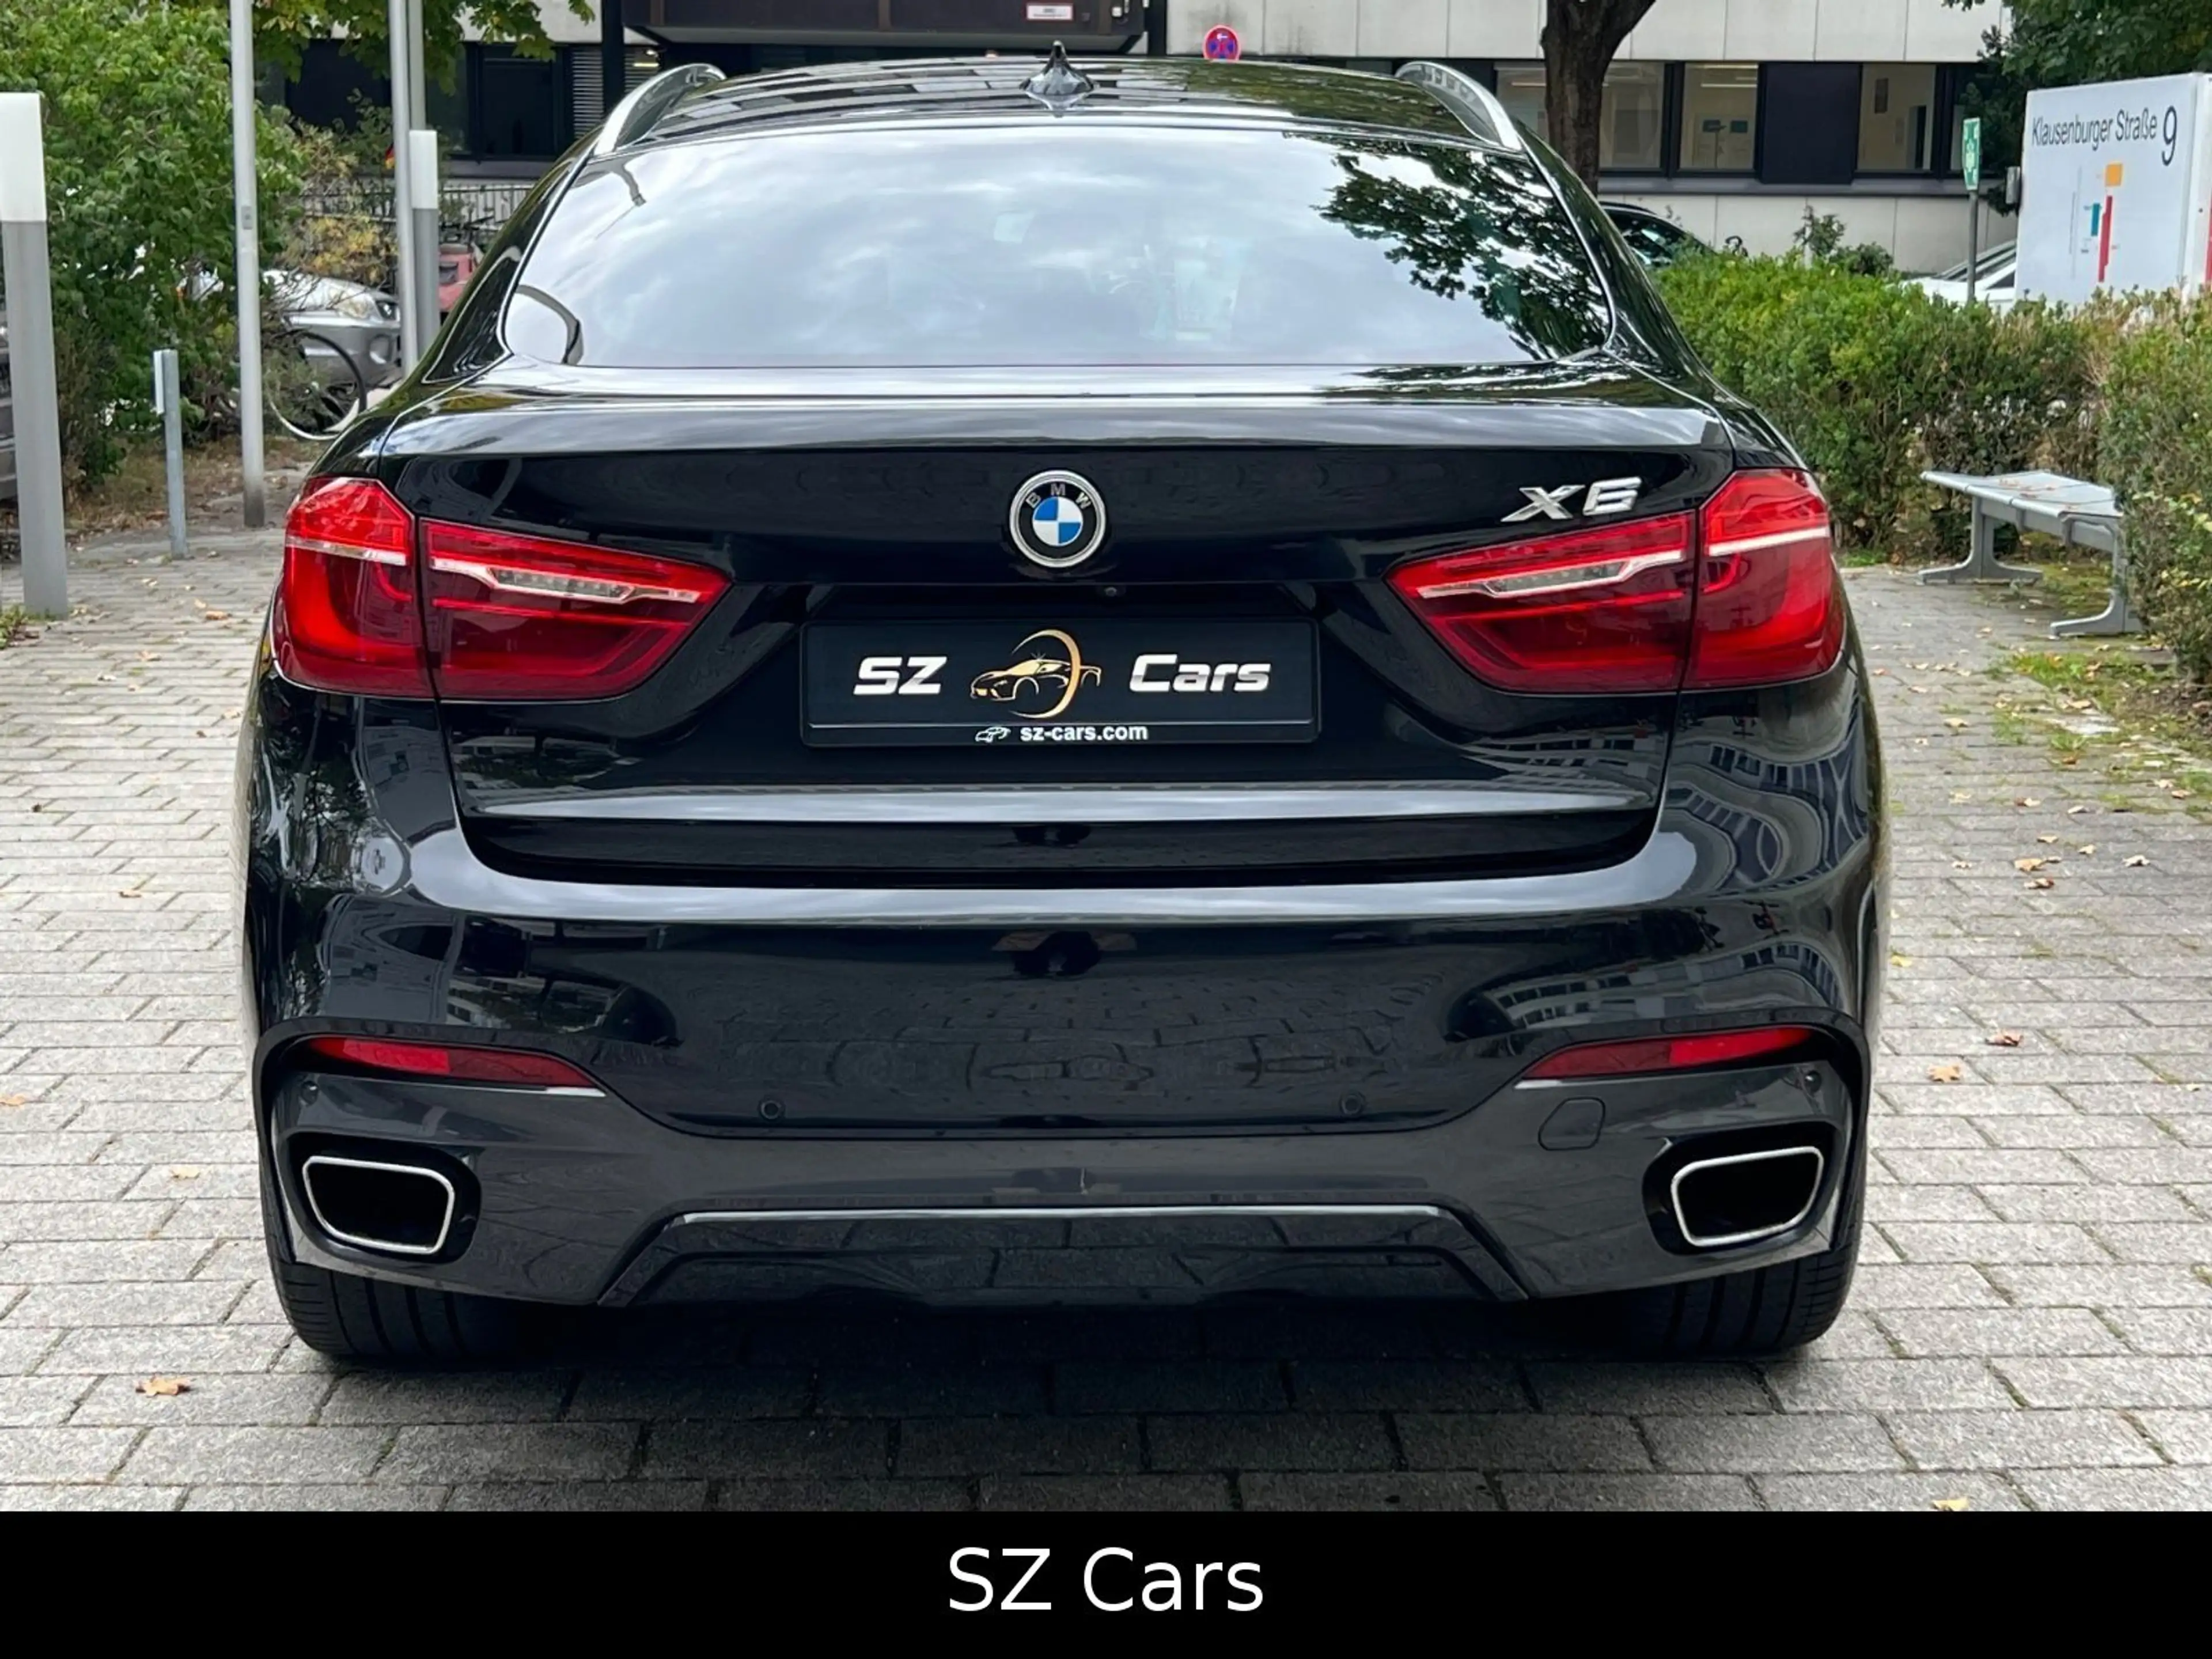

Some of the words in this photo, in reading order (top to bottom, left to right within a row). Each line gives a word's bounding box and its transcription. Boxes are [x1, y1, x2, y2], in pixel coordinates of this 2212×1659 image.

[2032, 115, 2113, 151] Klausenburger
[2115, 107, 2157, 141] Straße
[2161, 105, 2177, 166] 9
[1025, 483, 1092, 509] BMW
[1500, 476, 1642, 522] X6
[853, 656, 948, 695] SZ
[1129, 654, 1272, 692] Cars
[1020, 723, 1149, 743] sz-cars.com
